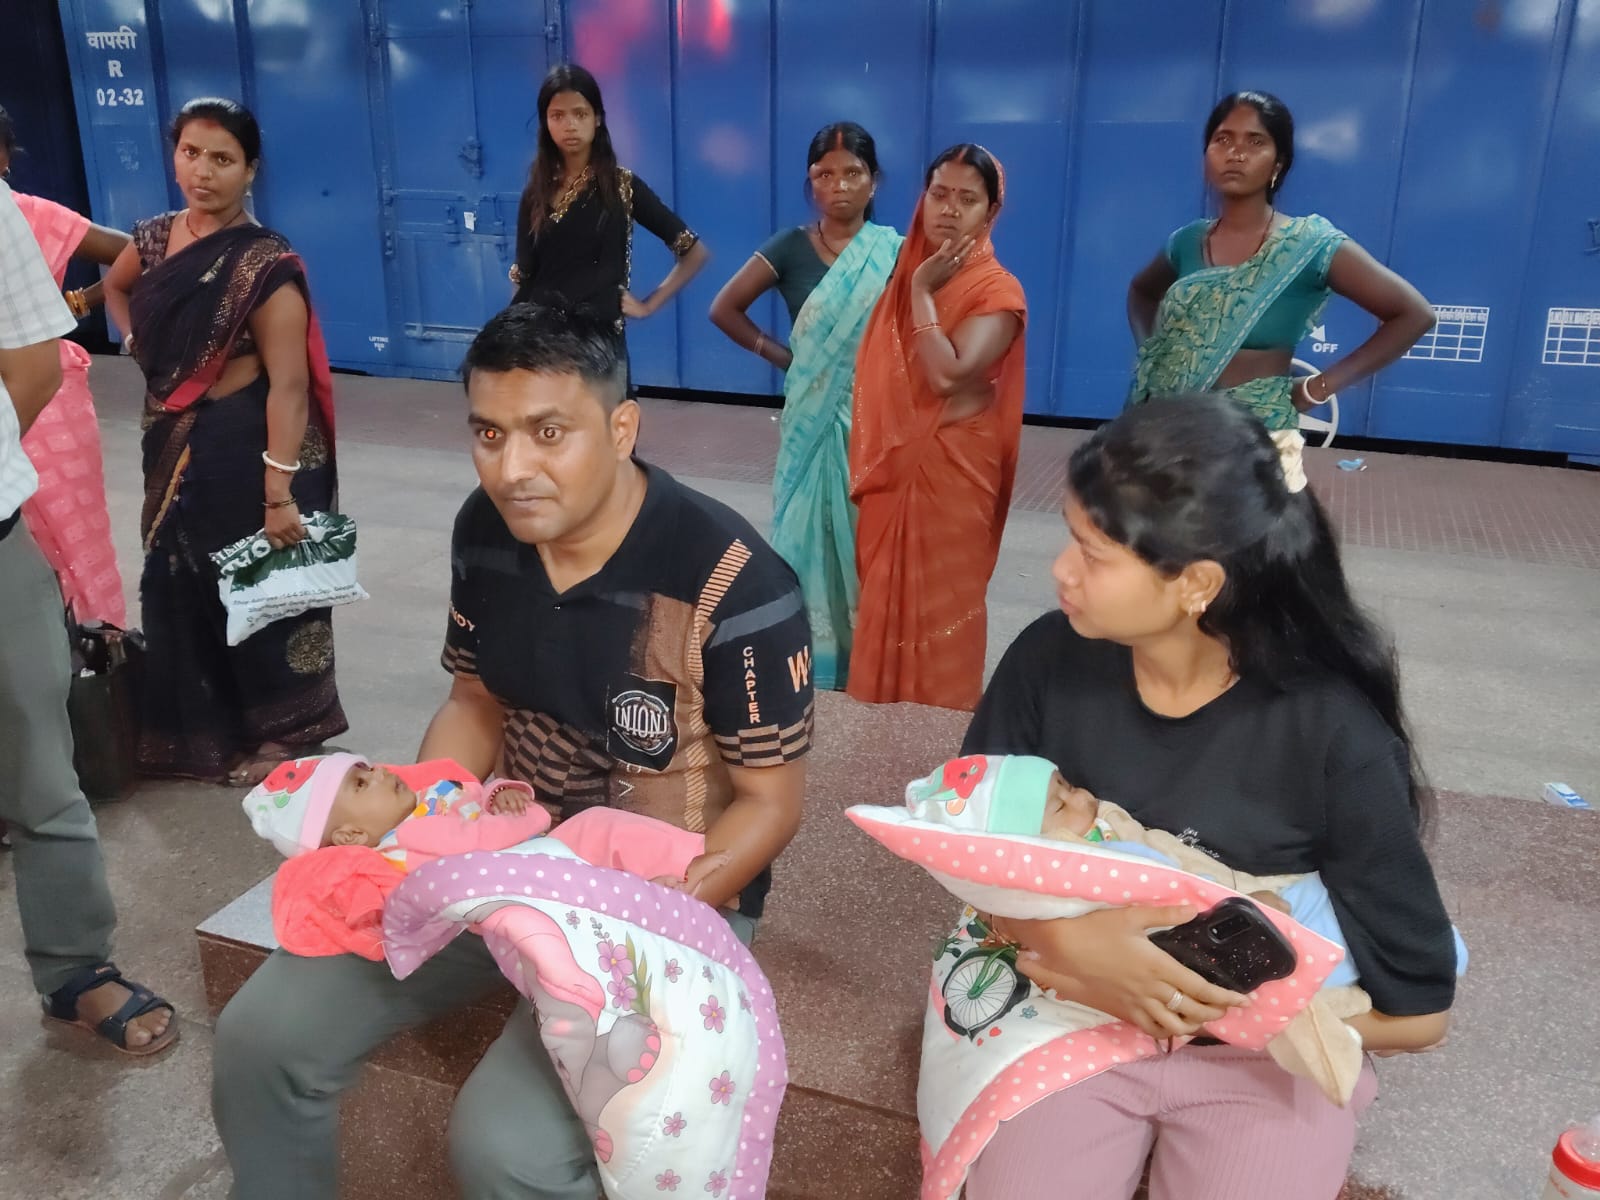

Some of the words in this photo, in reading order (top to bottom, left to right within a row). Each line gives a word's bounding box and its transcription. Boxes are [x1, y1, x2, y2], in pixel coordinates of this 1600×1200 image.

[86, 25, 137, 49] वापसी
[108, 60, 124, 77] R
[96, 88, 144, 106] 02-32
[1312, 342, 1339, 353] OFF
[787, 645, 812, 693] W
[742, 646, 761, 724] CHAPTER
